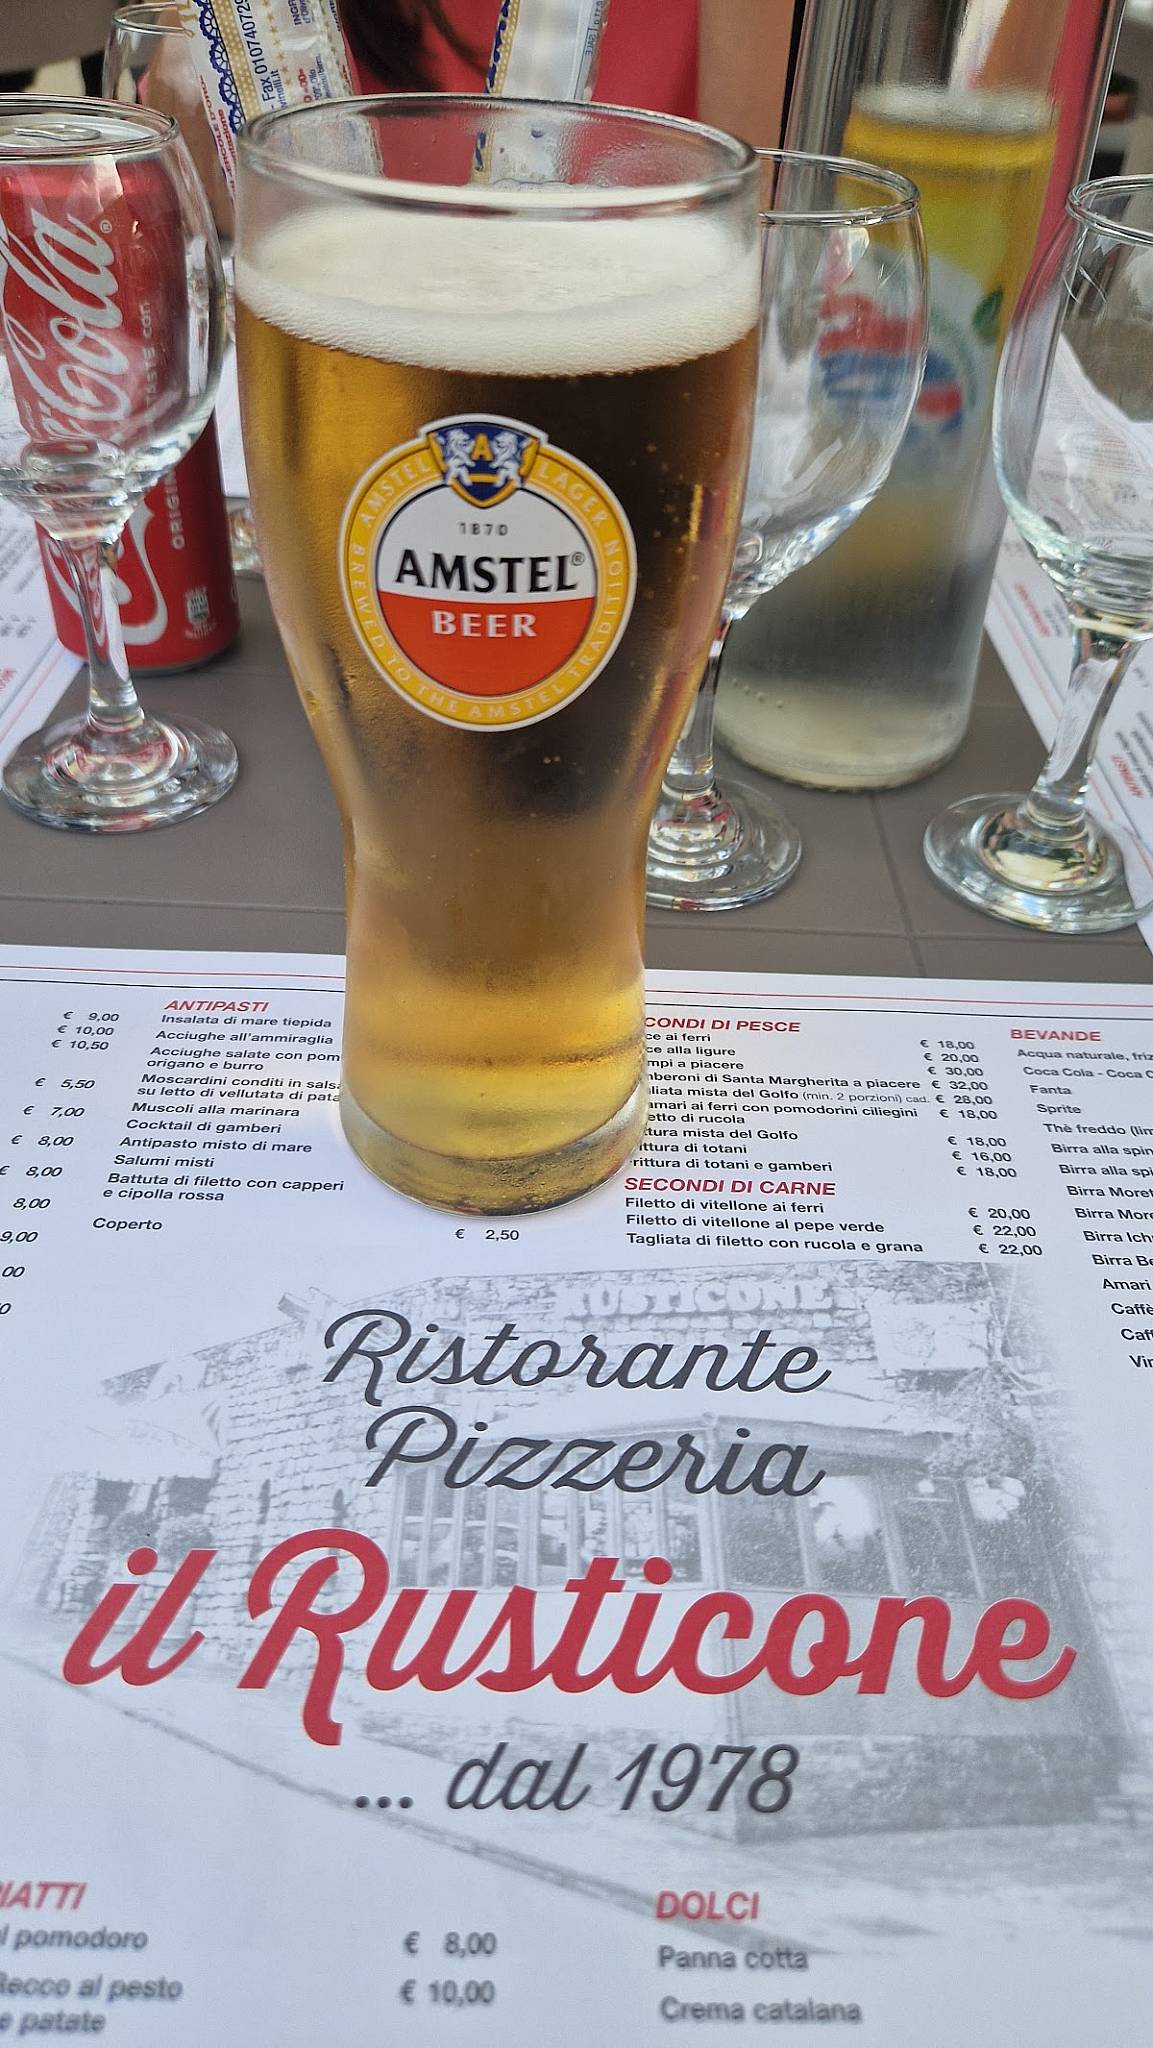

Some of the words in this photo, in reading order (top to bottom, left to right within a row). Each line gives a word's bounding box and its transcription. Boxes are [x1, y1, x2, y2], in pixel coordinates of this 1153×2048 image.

[261, 76, 277, 102] Fax
[360, 456, 432, 529] AMSTEL
[539, 458, 608, 524] LAGER
[350, 544, 386, 650] BREWED
[416, 683, 457, 714] THE
[468, 682, 565, 719] AMSTEL
[569, 538, 626, 679] TRADITION
[432, 610, 538, 638] BEER
[164, 1000, 269, 1012] ANTIPASTI
[88, 1012, 119, 1022] 9,00
[161, 1014, 219, 1024] Insalata
[283, 1018, 332, 1028] tiepida
[645, 1017, 705, 1029] CONDI
[711, 1019, 730, 1030] DI
[736, 1021, 800, 1032] PESCE
[76, 1026, 114, 1036] 10,00
[1010, 1029, 1101, 1041] BEVANDE
[155, 1030, 226, 1042] Acciughe
[230, 1033, 333, 1045] all'ammiraglia
[681, 1033, 711, 1042] ferri
[70, 1040, 109, 1050] 10,50
[937, 1040, 975, 1050] 18,00
[150, 1047, 221, 1059] Acciughe
[225, 1050, 270, 1059] salate
[275, 1052, 302, 1060] con
[307, 1053, 340, 1062] pom
[667, 1046, 691, 1054] alla
[696, 1046, 735, 1057] ligure
[1017, 1049, 1063, 1059] Acqua
[941, 1053, 979, 1063] 20,00
[147, 1059, 205, 1070] origano
[223, 1061, 264, 1070] burro
[690, 1060, 744, 1070] piacere
[945, 1067, 984, 1077] 30,00
[1023, 1066, 1060, 1076] Coca
[1062, 1068, 1095, 1077] Cola
[1106, 1069, 1143, 1078] Coca
[61, 1079, 95, 1090] 5,50
[141, 1074, 227, 1085] Moscardini
[231, 1078, 283, 1087] conditi
[722, 1074, 764, 1084] Santa
[769, 1076, 849, 1087] Margherita
[866, 1079, 920, 1089] piacere
[949, 1081, 989, 1091] 32,00
[160, 1087, 195, 1096] letto
[219, 1089, 284, 1099] vellutata
[687, 1087, 728, 1097] mista
[732, 1089, 754, 1098] del
[759, 1089, 799, 1099] Golfo
[1029, 1085, 1072, 1095] Fanta
[953, 1095, 993, 1105] 28,00
[51, 1107, 85, 1118] 7,00
[131, 1102, 194, 1113] Muscoli
[198, 1105, 225, 1114] alla
[230, 1106, 300, 1116] marinara
[707, 1102, 737, 1111] ferri
[774, 1105, 858, 1115] pomodorini
[862, 1107, 918, 1119] ciliegini
[958, 1110, 998, 1120] 18,00
[1036, 1103, 1081, 1115] Sprite
[698, 1115, 745, 1124] rucola
[126, 1119, 192, 1130] Cocktail
[216, 1123, 281, 1134] gamberi
[1076, 1124, 1126, 1134] freddo
[683, 1128, 725, 1138] mista
[729, 1129, 752, 1138] del
[757, 1130, 798, 1140] Golfo
[38, 1136, 74, 1147] 8,00
[119, 1137, 197, 1149] Antipasto
[202, 1140, 247, 1150] misto
[271, 1144, 312, 1153] mare
[966, 1137, 1007, 1147] 18,00
[703, 1144, 747, 1154] totani
[1051, 1143, 1089, 1153] Birra
[113, 1154, 171, 1166] Salumi
[174, 1157, 215, 1167] misti
[971, 1152, 1012, 1163] 16,00
[629, 1157, 680, 1168] rittura
[704, 1159, 749, 1169] totani
[768, 1161, 832, 1172] gamberi
[1058, 1164, 1097, 1175] Birra
[26, 1166, 63, 1178] 8,00
[976, 1167, 1017, 1178] 18,00
[108, 1173, 169, 1185] Battuta
[194, 1176, 241, 1187] filetto
[247, 1180, 277, 1188] con
[282, 1181, 344, 1192] capperi
[624, 1177, 724, 1192] SECONDI
[731, 1180, 752, 1193] DI
[760, 1181, 836, 1195] CARNE
[118, 1188, 173, 1200] cipolla
[178, 1192, 224, 1201] rossa
[1066, 1186, 1105, 1196] Birra
[13, 1198, 51, 1210] 8,00
[626, 1197, 676, 1209] Filetto
[700, 1200, 767, 1211] vitellone
[790, 1202, 824, 1213] ferri
[988, 1208, 1030, 1220] 20,00
[1074, 1208, 1114, 1219] Birra
[93, 1217, 162, 1231] Coperto
[626, 1214, 677, 1226] Filetto
[702, 1216, 770, 1229] vitellone
[794, 1222, 834, 1232] pepe
[839, 1221, 884, 1232] verde
[0, 1231, 38, 1244] 9,00
[485, 1229, 519, 1241] 2,50
[993, 1225, 1036, 1238] 22,00
[1083, 1231, 1123, 1242] Birra
[626, 1233, 690, 1246] Tagliata
[716, 1235, 763, 1247] filetto
[769, 1240, 799, 1248] con
[804, 1239, 856, 1250] rucola
[876, 1243, 923, 1254] grana
[998, 1244, 1042, 1256] 22,00
[1091, 1254, 1133, 1266] Birra
[1103, 1278, 1151, 1290] Amari
[1111, 1303, 1153, 1315] Caffè
[320, 1307, 833, 1409] Ristorante
[362, 1404, 829, 1500] Pizzeria
[62, 1545, 219, 1687] il
[237, 1527, 1078, 1747] Rusticone
[447, 1741, 591, 1813] dal
[613, 1743, 802, 1815] 1978
[0, 1881, 87, 1910] IATTI
[656, 1892, 760, 1920] DOLCI
[12, 1926, 148, 1952] pomodoro
[444, 1932, 497, 1959] 8,00
[658, 1945, 737, 1971] Panna
[744, 1945, 808, 1971] cotta
[106, 1977, 183, 2003] pesto
[428, 1980, 496, 2008] 10,00
[659, 1996, 746, 2024] Crema
[753, 1998, 863, 2025] catalana
[17, 2011, 106, 2037] patate
